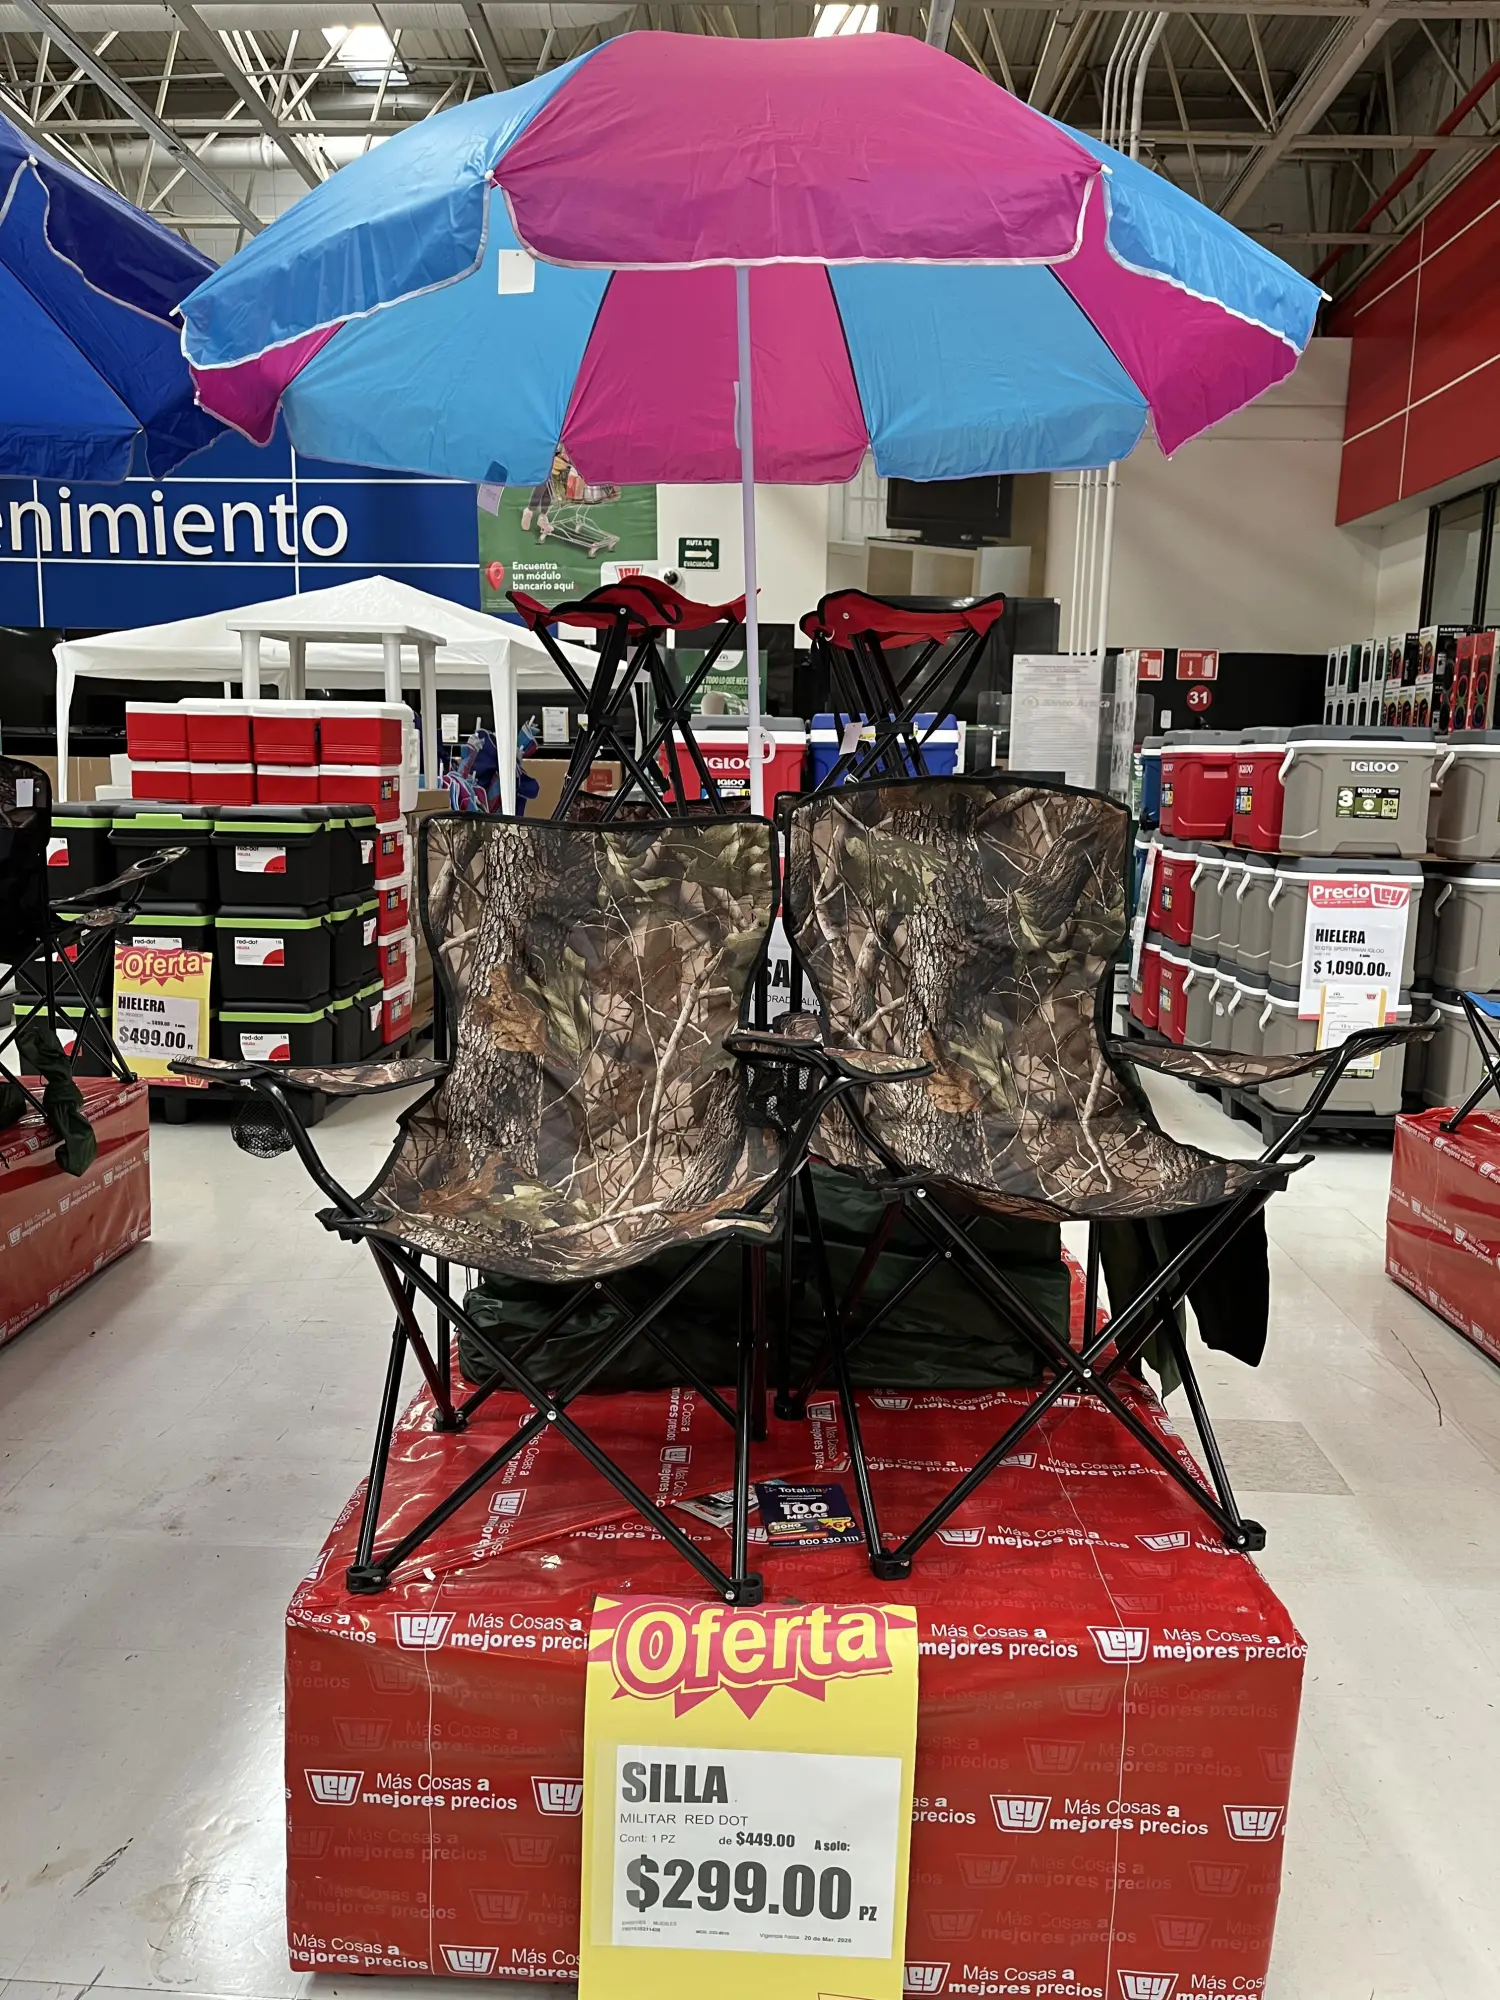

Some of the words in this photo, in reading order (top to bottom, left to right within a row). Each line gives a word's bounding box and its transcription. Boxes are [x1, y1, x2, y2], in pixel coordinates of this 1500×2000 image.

[0, 486, 349, 557] nimiento
[685, 539, 702, 547] RUTA
[512, 561, 558, 570] Encuentra
[526, 570, 561, 580] módulo
[512, 581, 552, 590] bancario
[1189, 691, 1209, 704] 31
[1351, 761, 1399, 773] IGLOO
[1338, 790, 1354, 807] 3
[1312, 884, 1370, 899] Precio
[1315, 929, 1366, 944] HIELERA
[125, 951, 200, 977] Oferta
[1313, 960, 1322, 975] $
[1326, 960, 1385, 977] 1,090.00
[118, 996, 166, 1013] HIELERA
[119, 1025, 186, 1049] $499.00
[914, 1401, 973, 1412] mejores
[953, 1394, 992, 1405] Cosas
[521, 1447, 541, 1470] Cosas
[898, 1458, 941, 1467] Cosas
[1048, 1458, 1074, 1469] Más
[1080, 1461, 1126, 1471] Cosas
[1130, 1461, 1142, 1471] a
[1039, 1464, 1107, 1477] mejores
[1112, 1467, 1168, 1478] precios
[778, 1486, 828, 1494] Totalplay
[780, 1502, 829, 1515] 100
[799, 1537, 820, 1546] 800
[822, 1536, 841, 1545] 330
[997, 1525, 1028, 1538] Más
[1034, 1527, 1084, 1539] Cosas
[1088, 1531, 1100, 1540] a
[988, 1533, 1064, 1550] mejores
[1068, 1536, 1131, 1550] precios
[337, 1613, 350, 1626] a
[467, 1612, 504, 1629] Más
[510, 1614, 564, 1630] Cosas
[568, 1616, 583, 1631] a
[931, 1623, 968, 1638] Más
[973, 1624, 1028, 1639] Cosas
[1034, 1627, 1048, 1640] a
[1162, 1627, 1201, 1643] Más
[1205, 1628, 1262, 1644] Cosas
[1267, 1634, 1281, 1645] a
[451, 1631, 537, 1651] mejores
[624, 1603, 880, 1685] Oferta
[918, 1640, 1003, 1661] mejores
[1008, 1640, 1079, 1661] precios
[1152, 1644, 1240, 1662] mejores
[1244, 1643, 1308, 1662] precios
[376, 1772, 412, 1791] Más
[417, 1773, 472, 1791] Cosas
[476, 1778, 490, 1792] a
[621, 1761, 729, 1804] SILLA
[362, 1791, 446, 1809] mejores
[451, 1793, 518, 1811] precios
[934, 1796, 948, 1808] a
[1064, 1798, 1101, 1816] Más
[1107, 1800, 1161, 1816] Cosas
[1166, 1804, 1180, 1818] a
[620, 1813, 676, 1825] MILITAR
[685, 1814, 715, 1826] RED
[718, 1815, 749, 1827] DOT
[1049, 1815, 1134, 1834] mejores
[1139, 1818, 1209, 1836] precios
[619, 1833, 648, 1843] Cont:
[651, 1834, 657, 1844] 1
[660, 1834, 676, 1844] PZ
[718, 1836, 732, 1845] de
[735, 1831, 796, 1848] $449.00
[814, 1839, 822, 1851] A
[823, 1840, 851, 1852] solo:
[625, 1854, 852, 1921] $299.00
[858, 1906, 878, 1922] PZ
[292, 1932, 327, 1949] Más
[331, 1938, 383, 1954] Cosas
[387, 1944, 400, 1957] a
[364, 1956, 429, 1971] precios
[511, 1948, 547, 1965] Más
[498, 1965, 579, 1980] mejores
[962, 1964, 999, 1981] Más
[1004, 1966, 1057, 1981] Cosas
[1061, 1966, 1075, 1980] a
[948, 1980, 1031, 1998] mejores
[1035, 1982, 1103, 1999] precios
[1190, 1974, 1226, 1990] Más
